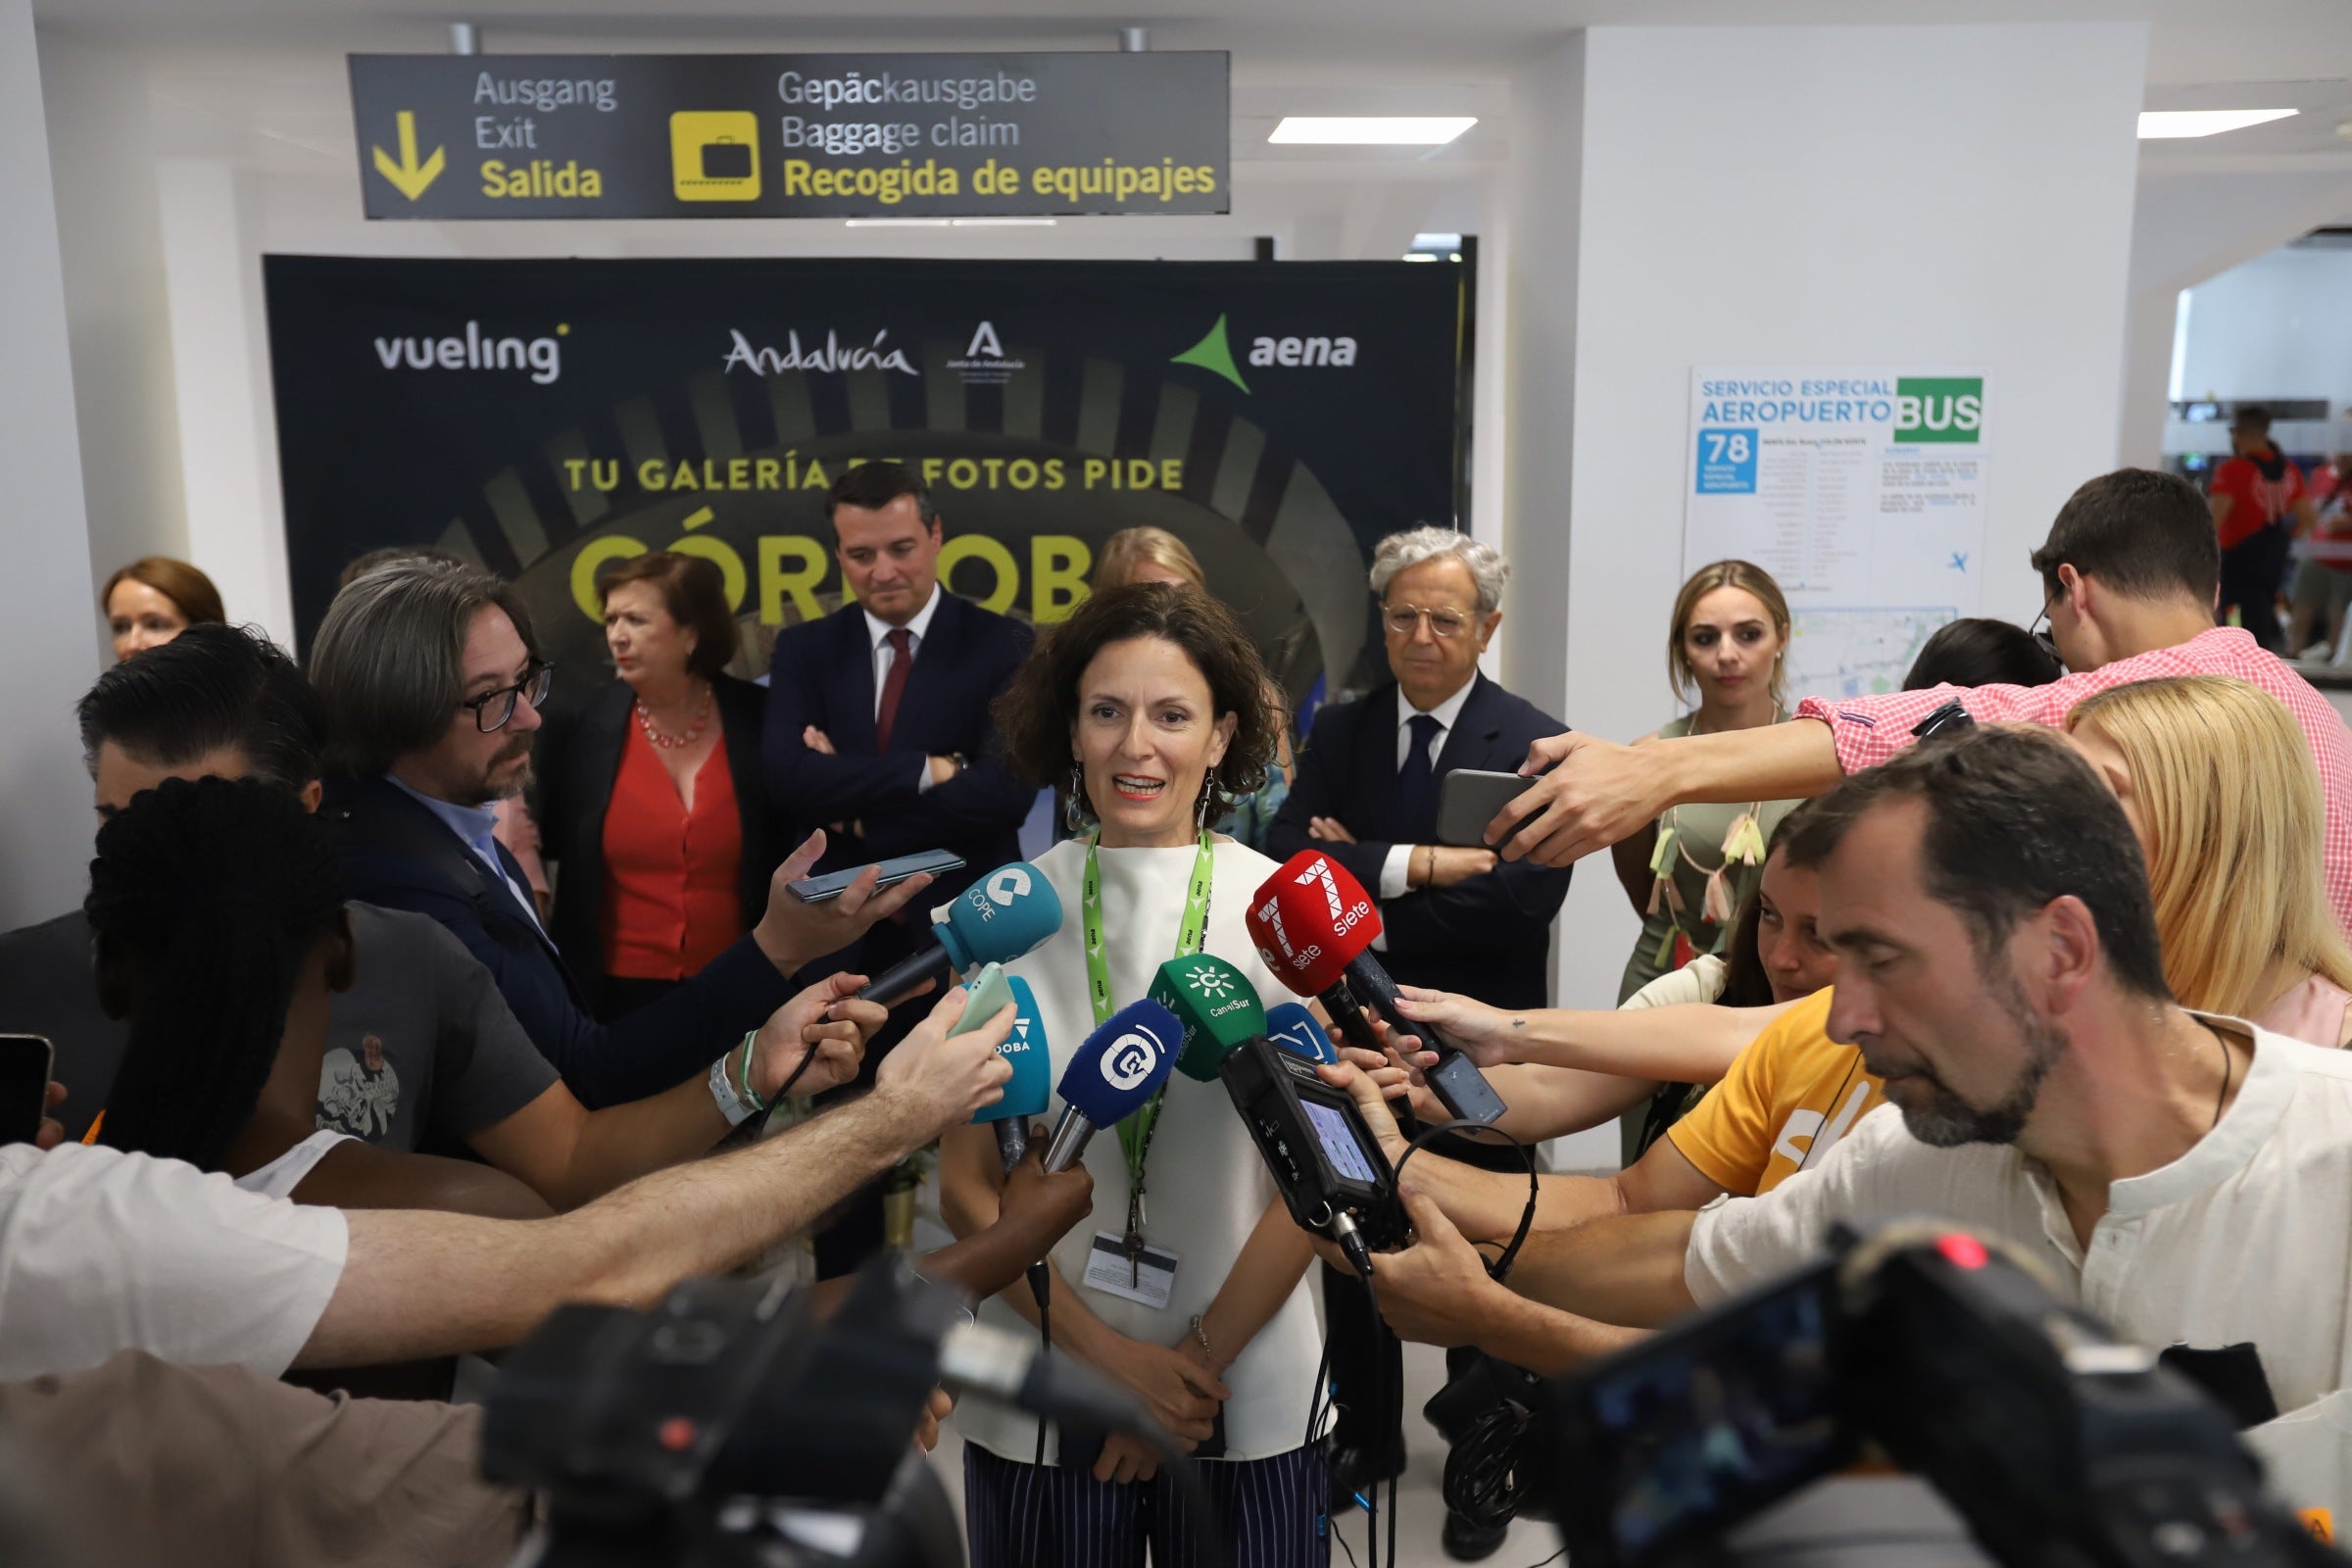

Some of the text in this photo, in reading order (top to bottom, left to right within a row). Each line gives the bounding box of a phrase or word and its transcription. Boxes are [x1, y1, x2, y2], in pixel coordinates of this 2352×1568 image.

[473, 71, 618, 112] Ausgang
[778, 71, 1036, 111] Gepäckausgabe
[475, 116, 537, 148] Exit
[782, 115, 1019, 155] Baggage claim
[480, 159, 602, 197] Salida
[785, 157, 1216, 204] Recogida de equipajes
[374, 319, 569, 384] vueling
[722, 327, 920, 376] Andalucía
[1249, 336, 1357, 367] aena
[1702, 380, 1892, 397] SERVICIO ESPECIAL
[1702, 401, 1891, 422] AEROPUERTO
[1895, 394, 1981, 431] BUS
[1705, 433, 1750, 464] 78
[564, 459, 619, 491] TU
[638, 450, 830, 490] GALERÍA
[922, 459, 1065, 489] FOTOS
[1084, 459, 1182, 489] PIDE
[968, 888, 996, 922] COPE
[994, 1041, 1030, 1054] DOBA
